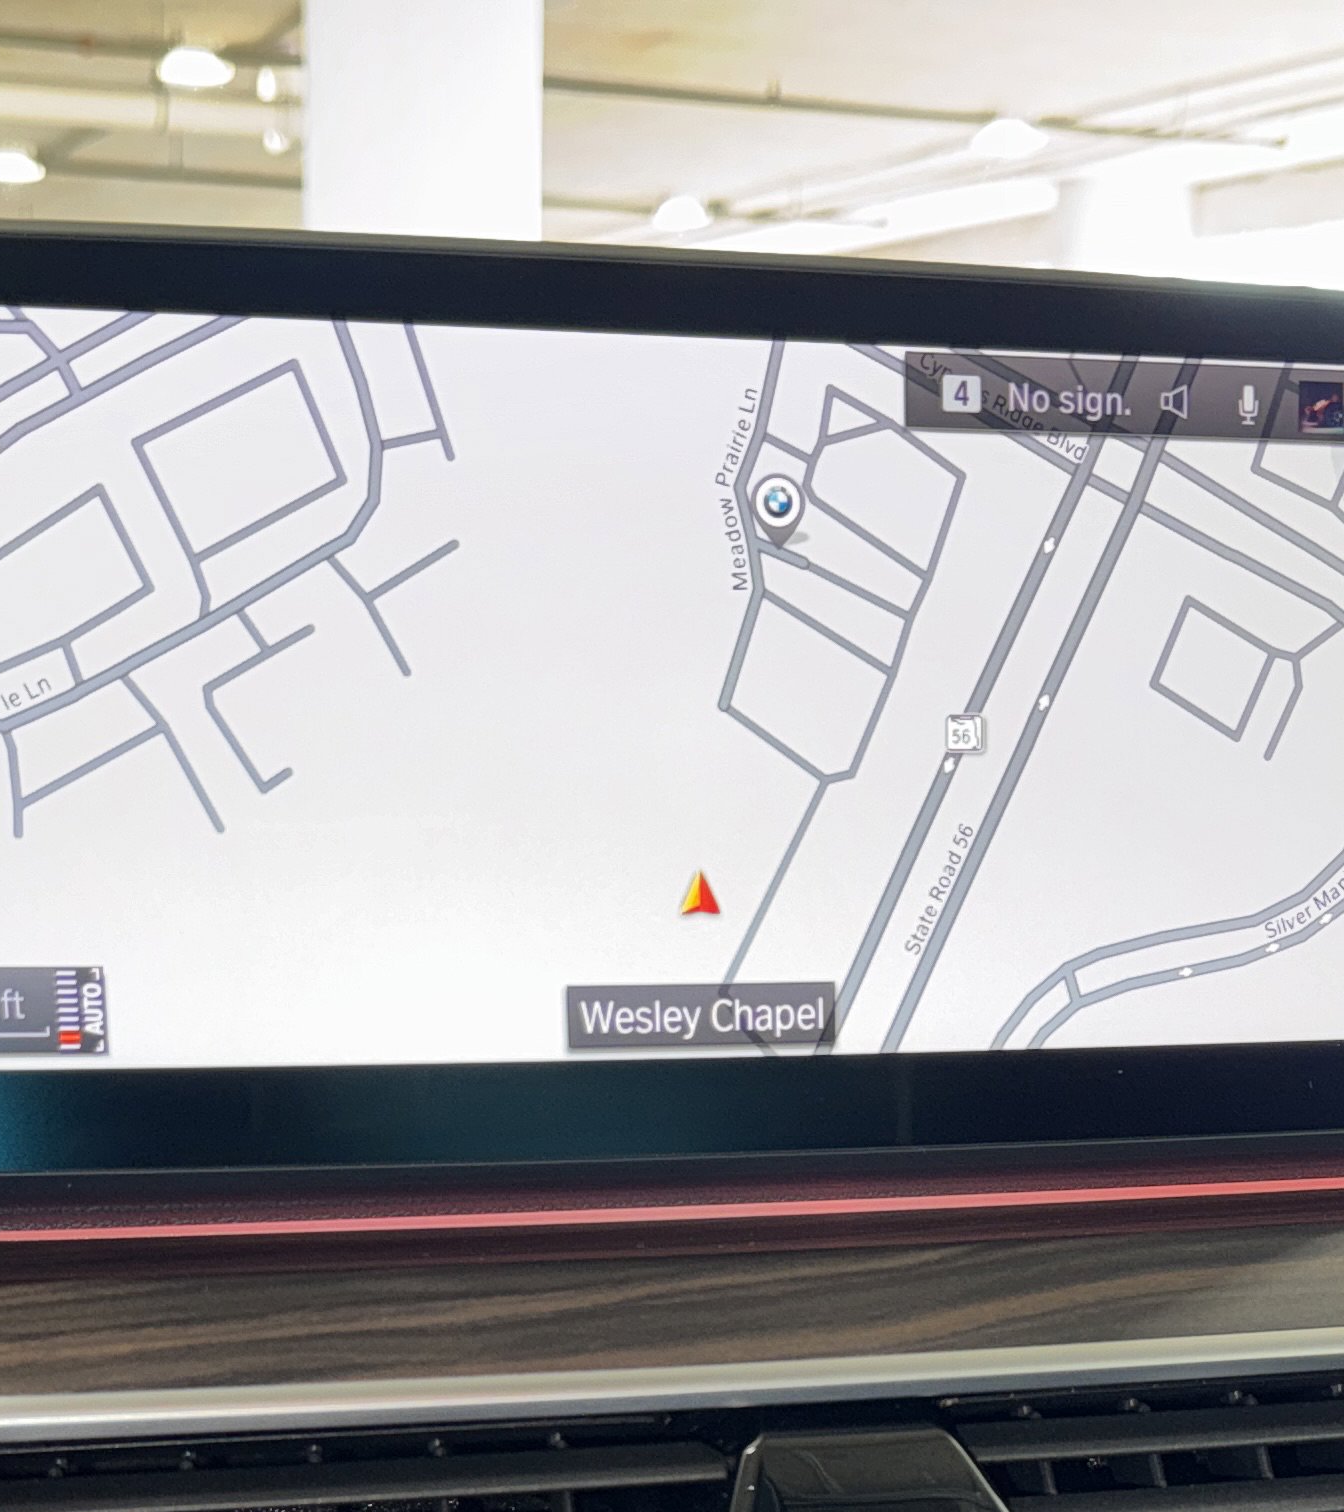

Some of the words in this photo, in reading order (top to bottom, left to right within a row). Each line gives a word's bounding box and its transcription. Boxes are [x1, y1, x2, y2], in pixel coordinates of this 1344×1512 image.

[738, 387, 758, 414] Ln
[954, 380, 970, 407] 4
[1008, 382, 1050, 413] No
[1059, 385, 1132, 422] sign.
[715, 418, 752, 488] Prairie
[1046, 429, 1089, 461] Blvd
[720, 498, 748, 591] Meadow
[23, 677, 52, 700] Ln
[951, 728, 971, 744] 56
[904, 904, 938, 955] State
[928, 851, 962, 903] Road
[953, 823, 974, 849] 56
[1264, 905, 1312, 938] Silver
[0, 988, 26, 1020] ft
[83, 983, 105, 1036] AUTO
[580, 999, 702, 1040] Wesley
[712, 997, 825, 1038] Chapel
